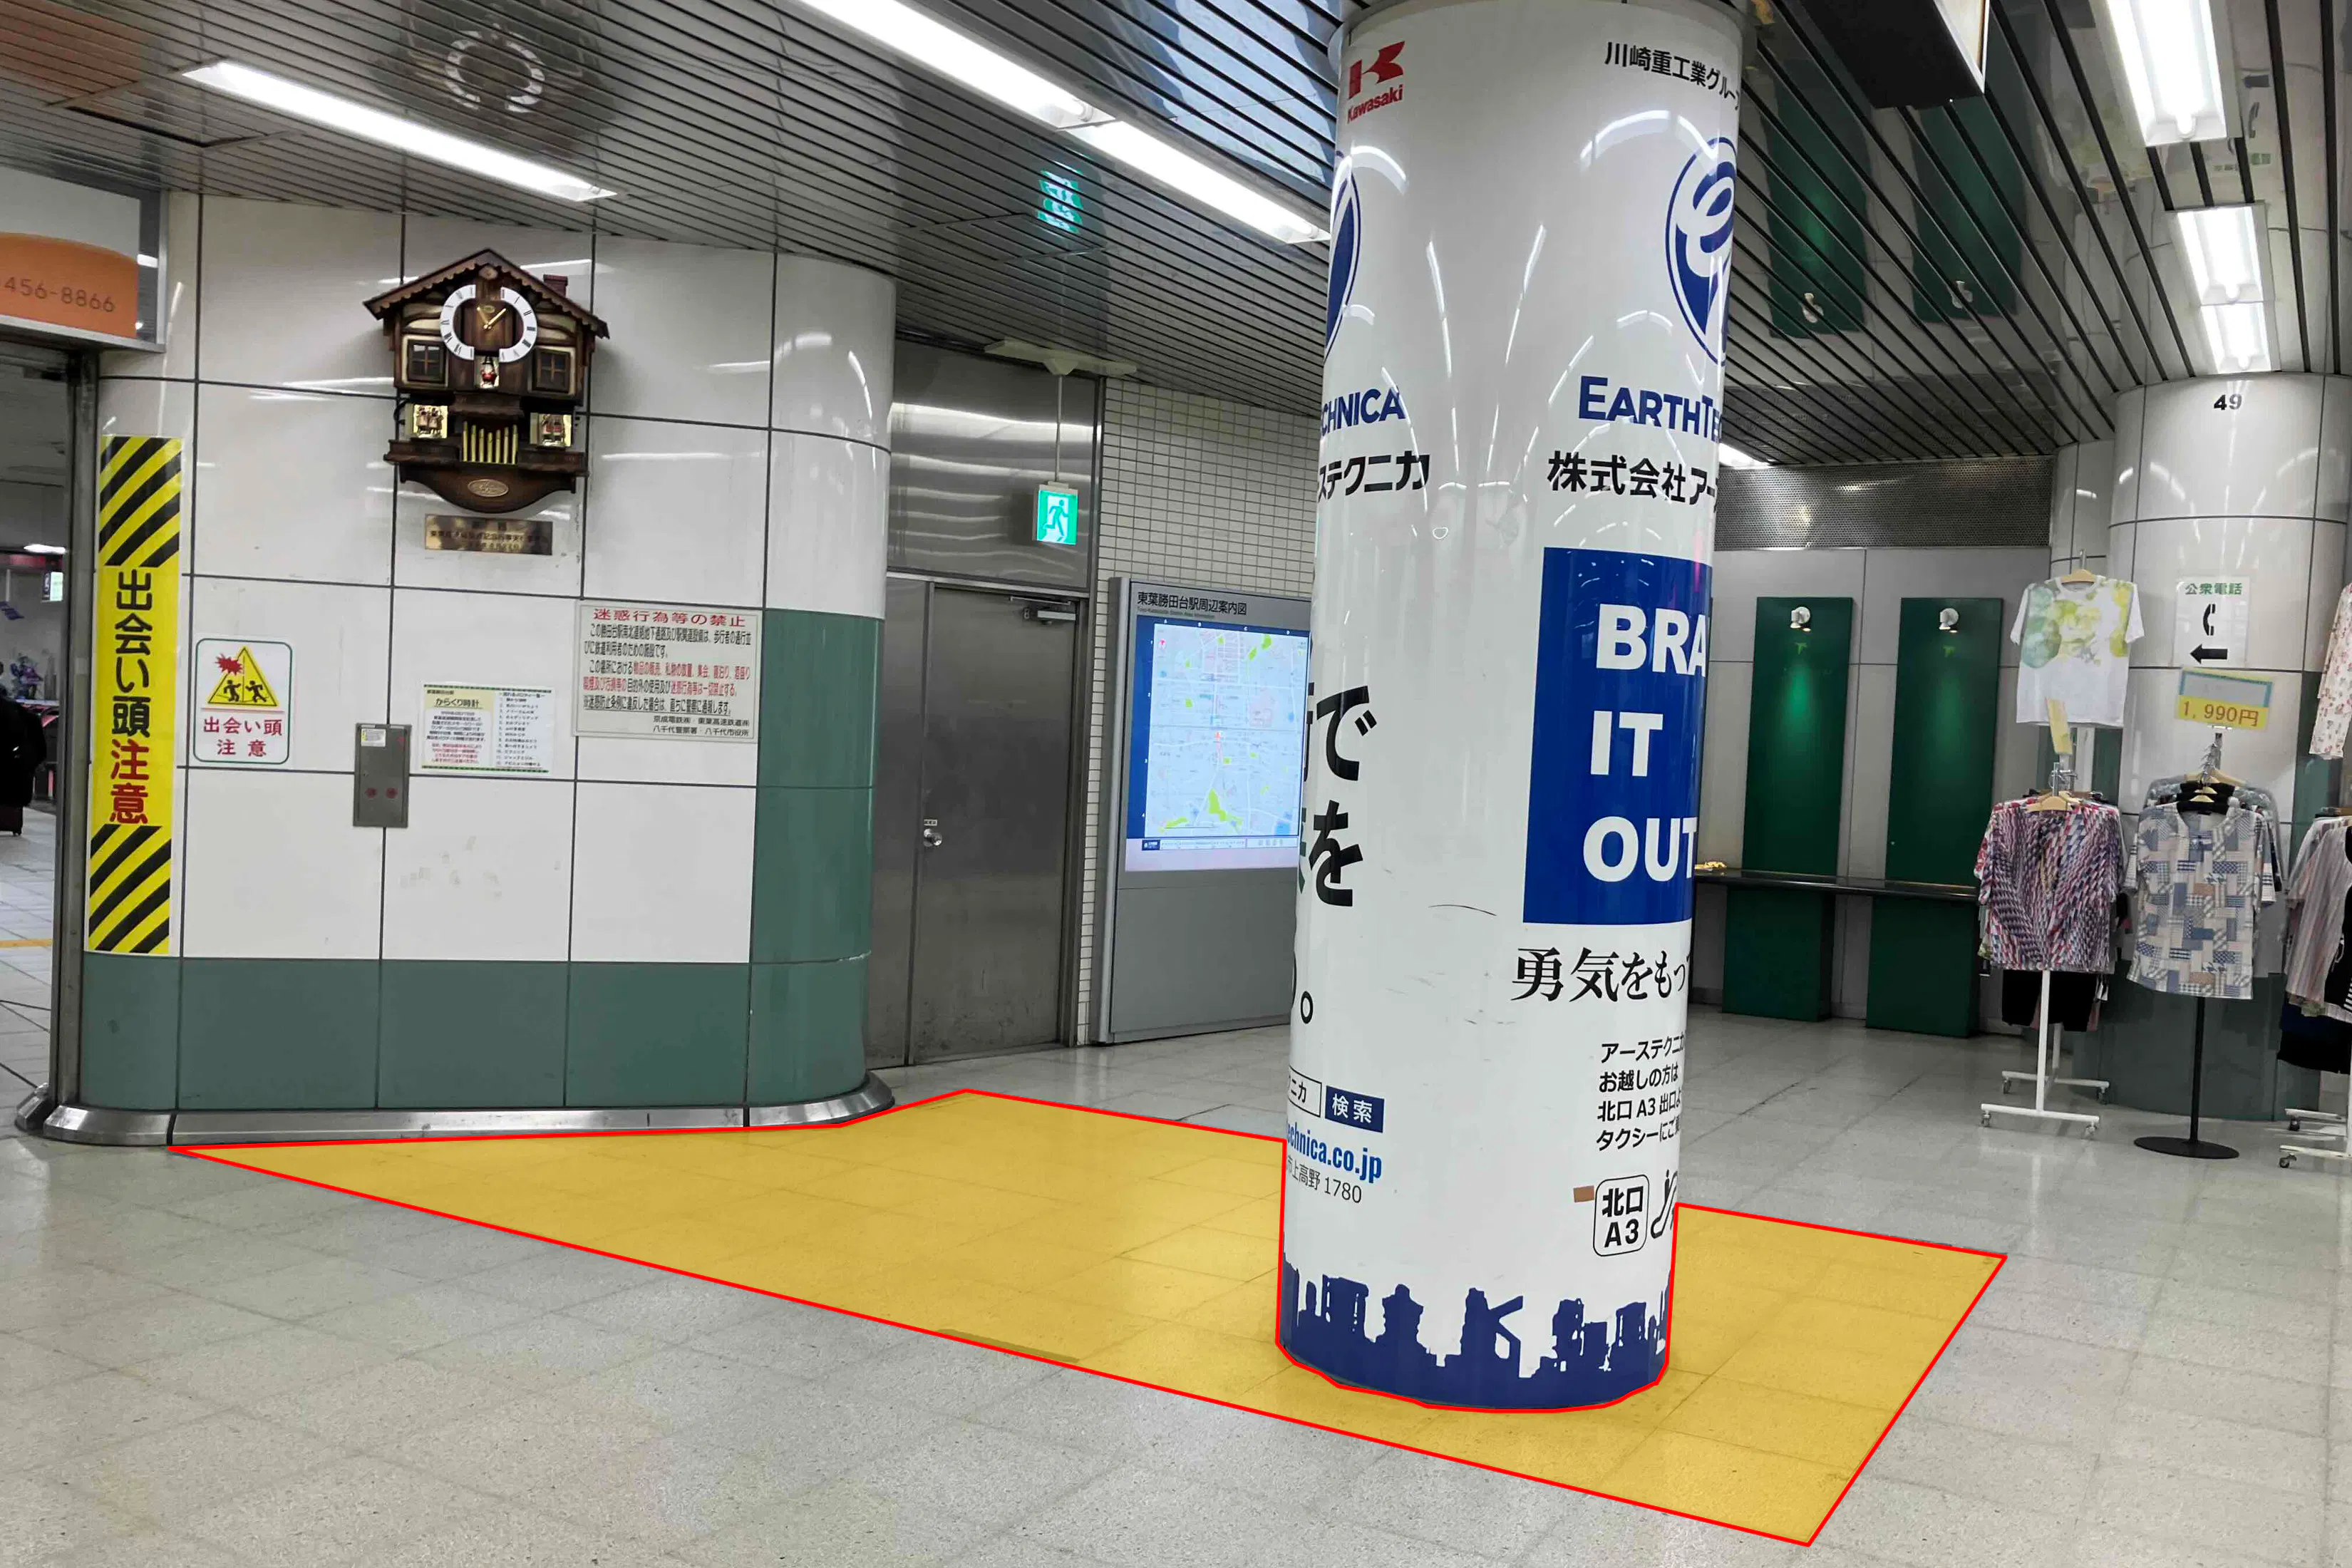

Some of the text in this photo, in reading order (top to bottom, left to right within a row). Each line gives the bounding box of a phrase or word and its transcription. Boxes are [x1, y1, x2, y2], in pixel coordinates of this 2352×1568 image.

[1347, 84, 1403, 123] Kawasaki
[2213, 393, 2242, 411] 49
[1547, 450, 1718, 513] 株式会社アー
[1138, 592, 1247, 615] 東葉勝田台駅周辺案内図
[2185, 582, 2243, 595] 公衆電話
[592, 607, 746, 627] 迷惑行為等の禁止
[1595, 603, 1707, 677] BRA
[110, 568, 153, 825] 出会い頭注意
[203, 716, 283, 736] 出会い頭
[1589, 710, 1664, 777] IT
[1510, 947, 1690, 1003] 勇気をもっ
[1599, 1061, 1678, 1093] お越しの方は
[1331, 1093, 1373, 1124] 検索
[1597, 1100, 1633, 1123] 北口
[1636, 1097, 1656, 1118] A3
[1286, 1120, 1382, 1184] echnica.co.jp
[1324, 1177, 1362, 1204] 1780
[1601, 1185, 1644, 1218] 北口
[1604, 1218, 1640, 1249] A3
